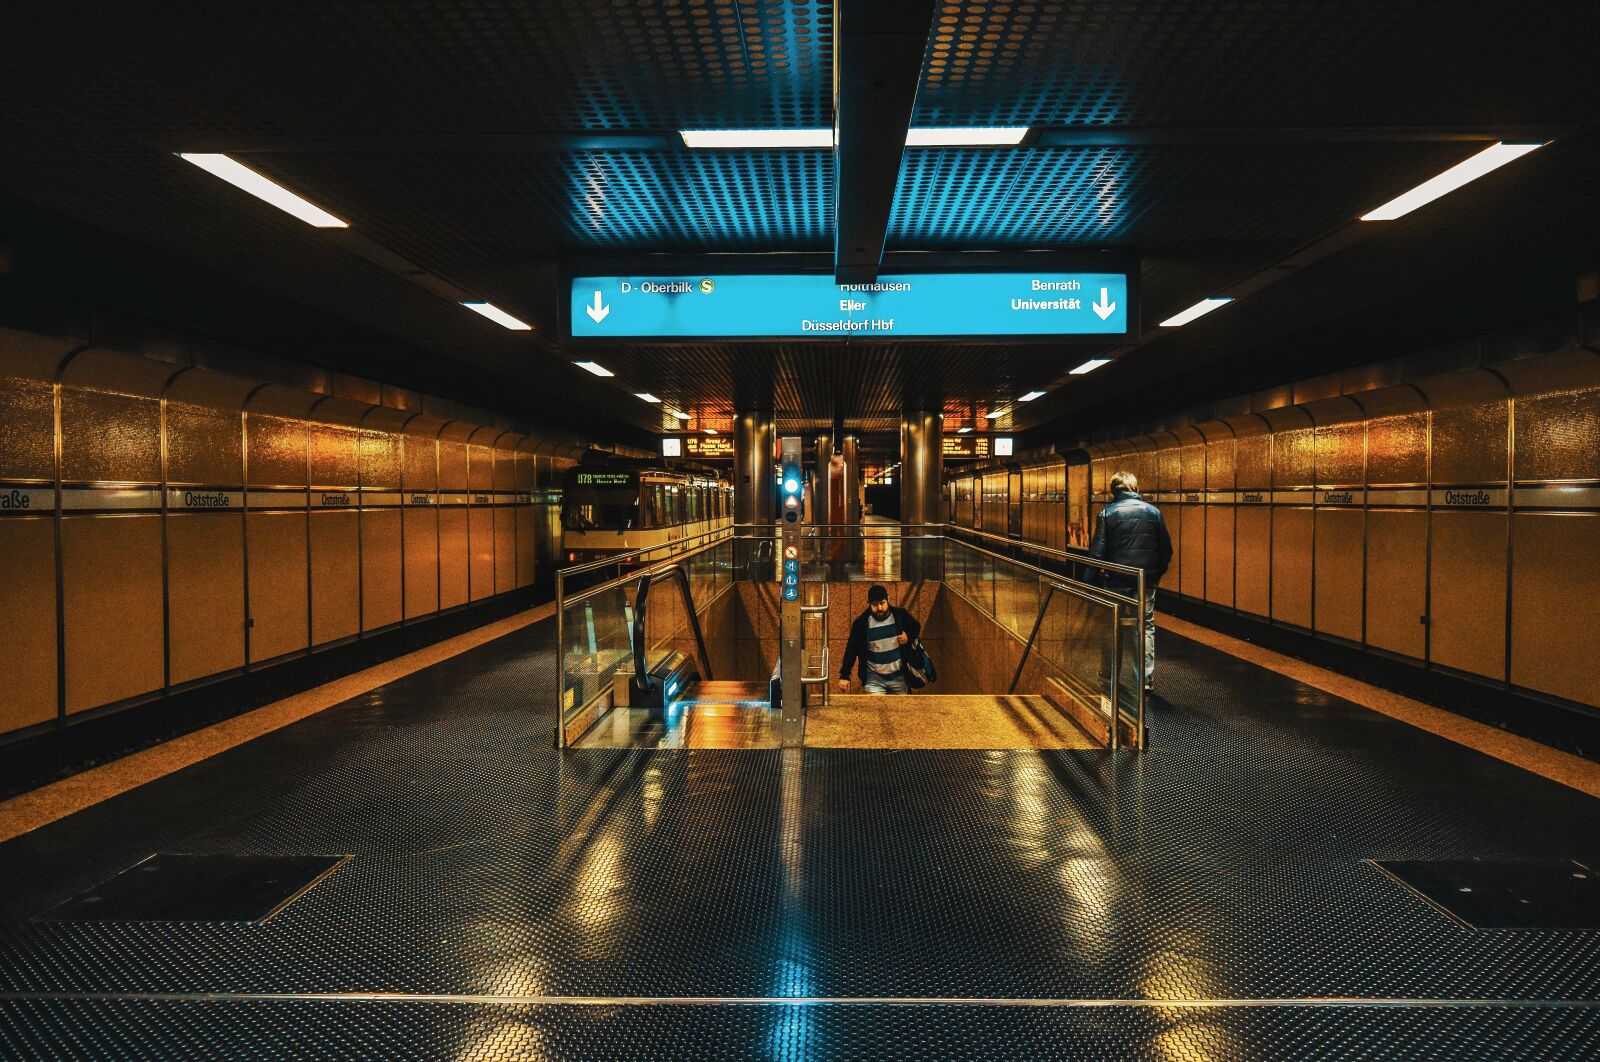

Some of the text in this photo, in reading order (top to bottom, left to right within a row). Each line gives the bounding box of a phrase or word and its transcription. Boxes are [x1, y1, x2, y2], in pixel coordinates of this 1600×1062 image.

[621, 282, 631, 293] D
[641, 281, 693, 293] Oberbilk
[1031, 279, 1081, 291] Benrath
[839, 299, 867, 311] Eller
[1011, 298, 1081, 310] Universität
[801, 319, 894, 331] Düsseldorf Hbf
[185, 491, 230, 507] Oststraße
[321, 493, 351, 506] Oststraße
[1445, 490, 1491, 505] Oststraße
